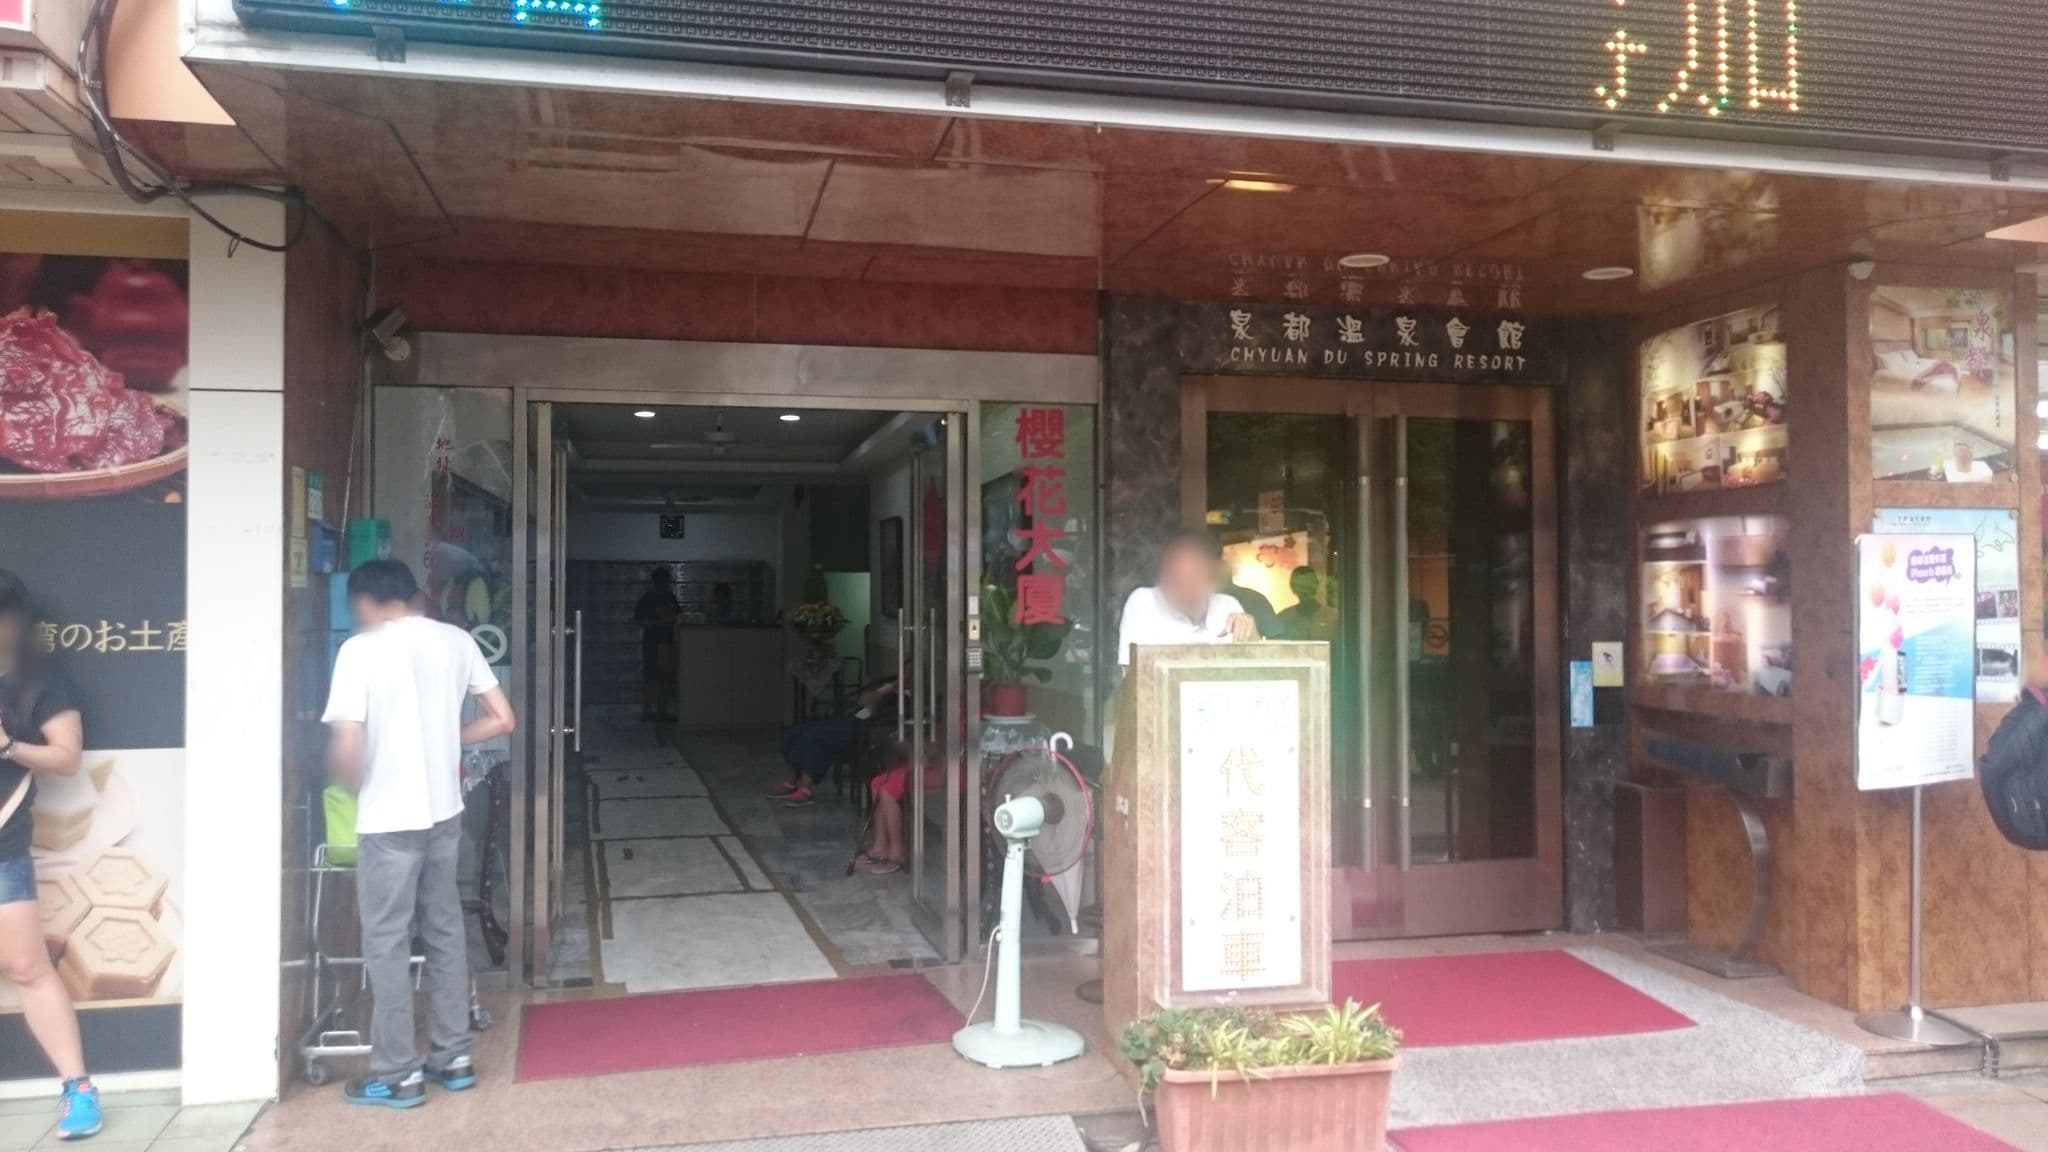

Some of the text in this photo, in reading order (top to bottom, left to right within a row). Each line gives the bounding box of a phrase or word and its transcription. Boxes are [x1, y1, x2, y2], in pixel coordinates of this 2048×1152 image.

[1231, 347, 1527, 371] CHYUAN DU SPRING RESORT
